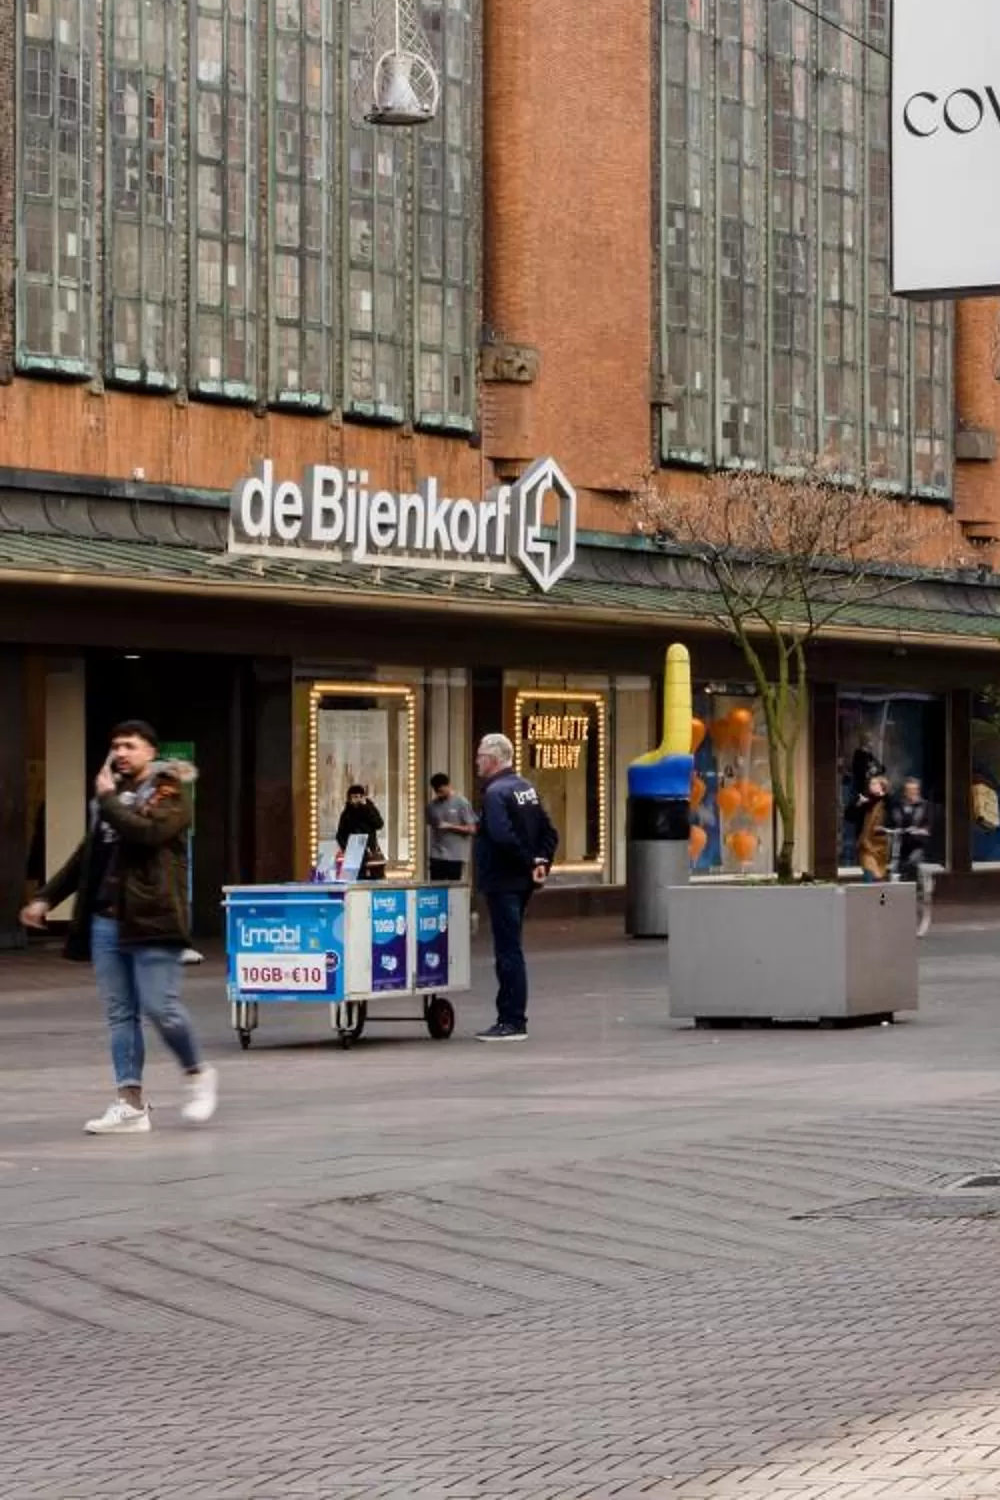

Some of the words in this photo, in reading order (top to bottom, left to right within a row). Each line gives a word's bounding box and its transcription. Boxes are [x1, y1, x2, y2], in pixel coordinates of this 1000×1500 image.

[240, 458, 302, 540] de
[310, 464, 511, 562] Bijenkorf
[528, 715, 589, 740] CHARLOTTE
[241, 966, 283, 983] 10GB
[291, 966, 321, 983] €10
